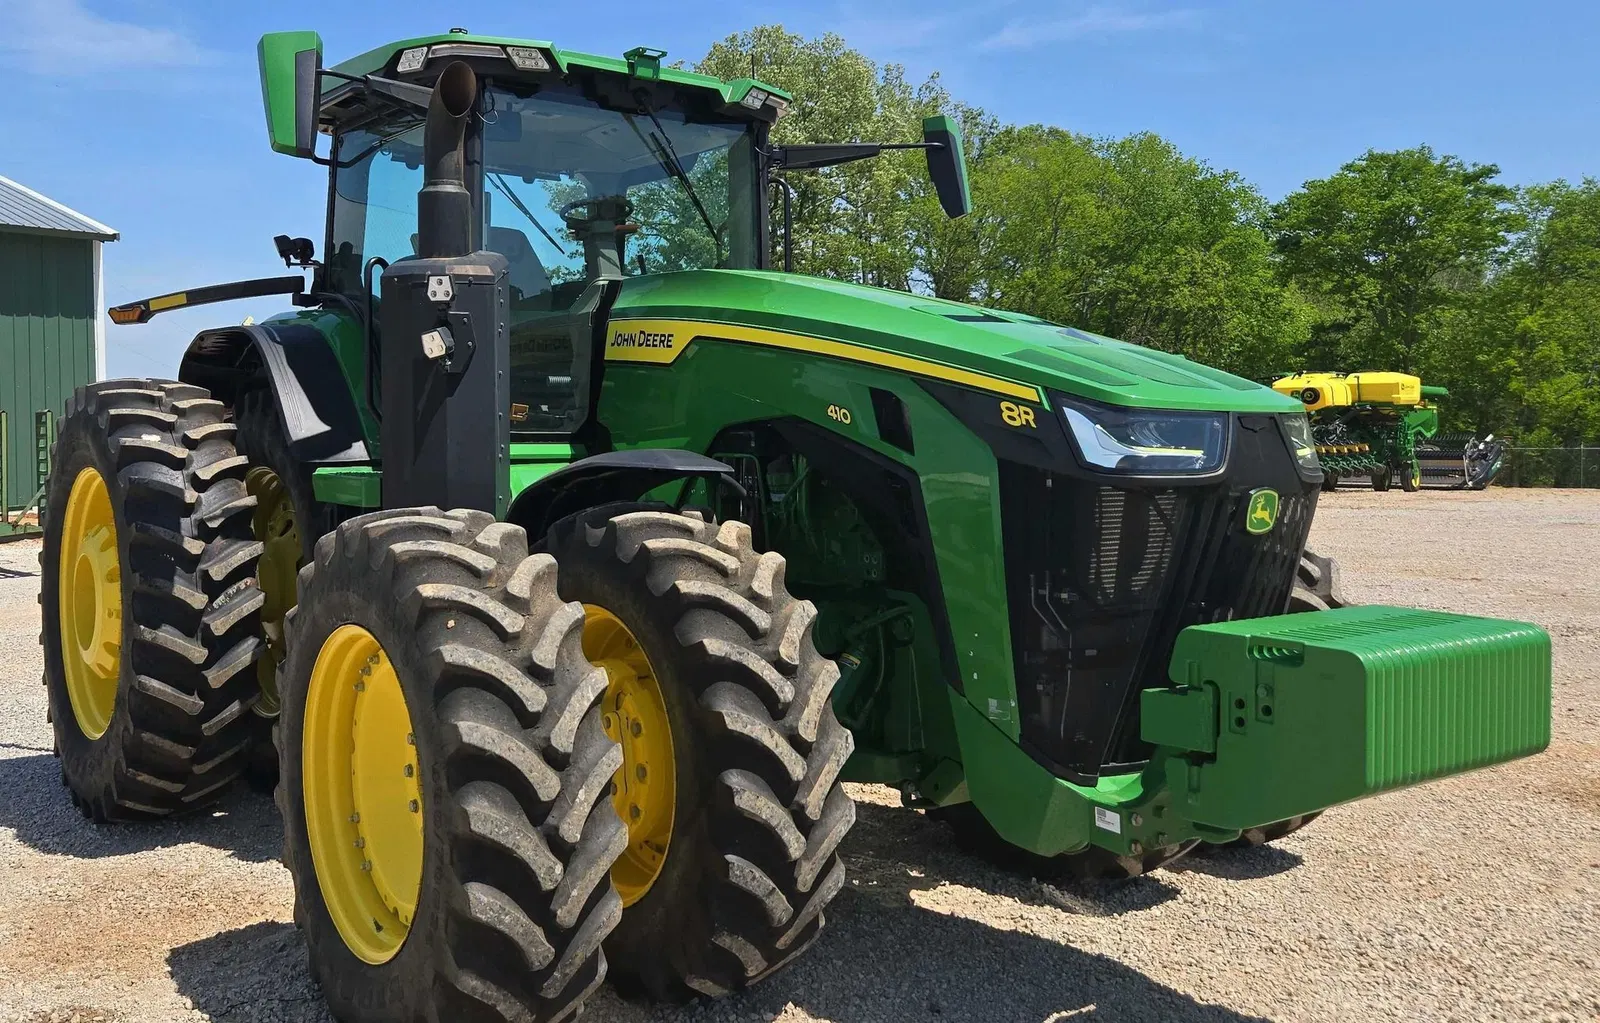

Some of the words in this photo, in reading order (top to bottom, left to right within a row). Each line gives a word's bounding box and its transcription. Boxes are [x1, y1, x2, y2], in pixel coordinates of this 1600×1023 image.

[610, 330, 637, 347] JOHN
[638, 329, 674, 349] DEERE
[827, 404, 851, 425] 410
[1000, 401, 1037, 429] 8R
